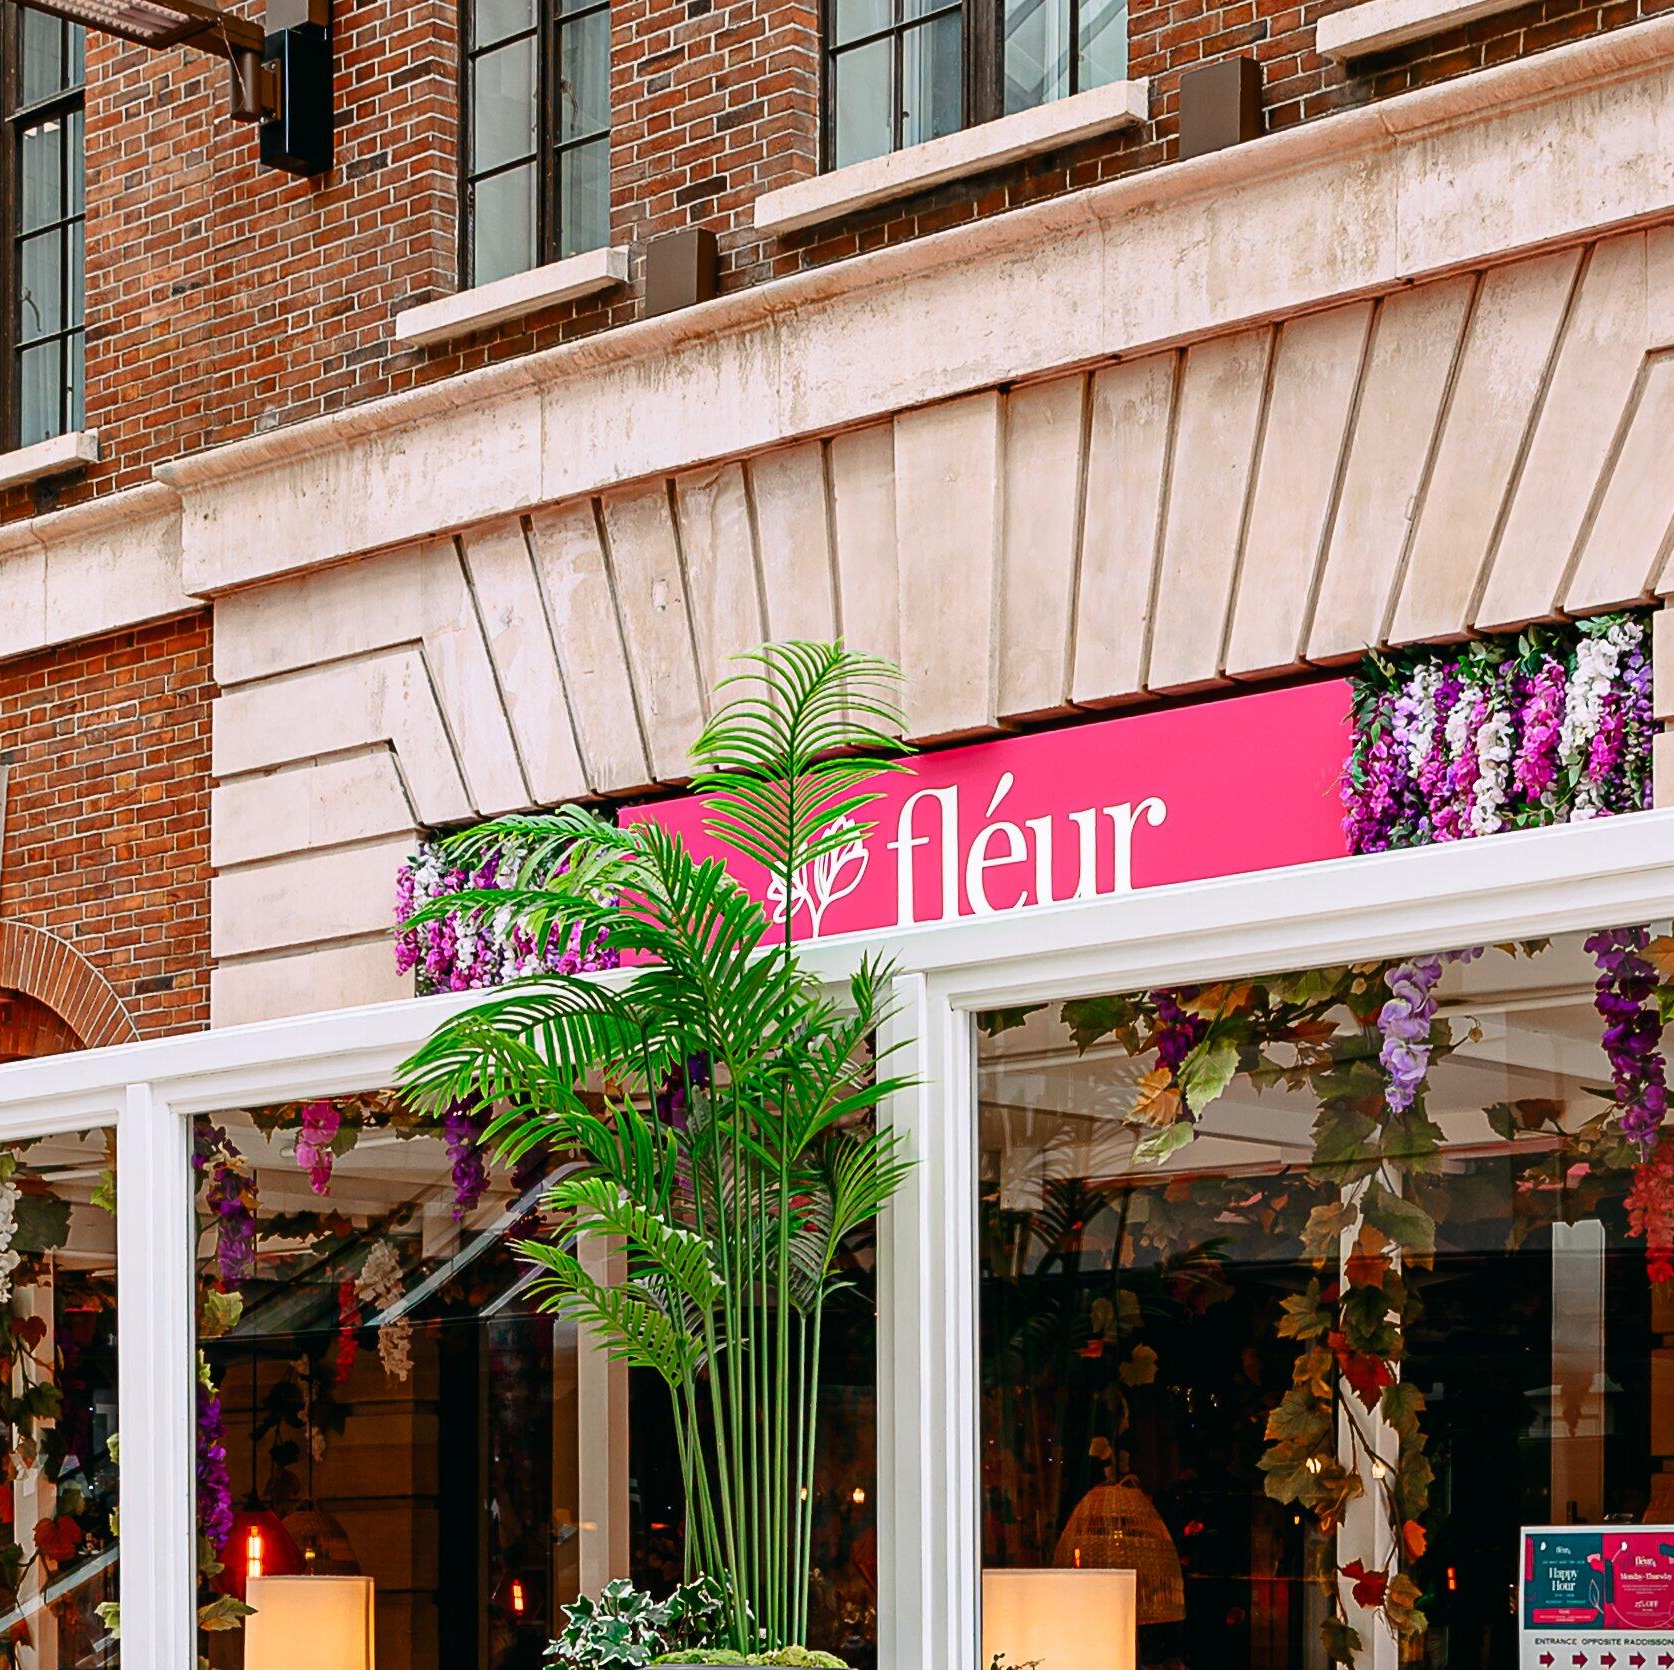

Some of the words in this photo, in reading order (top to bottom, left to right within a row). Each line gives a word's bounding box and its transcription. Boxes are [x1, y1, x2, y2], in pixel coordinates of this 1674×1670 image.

[887, 771, 1167, 926] fléur
[1549, 1567, 1577, 1581] Happy
[1552, 1580, 1576, 1591] Hour
[1534, 1637, 1577, 1645] ENTRANCE
[1581, 1638, 1622, 1646] OPPOSITE
